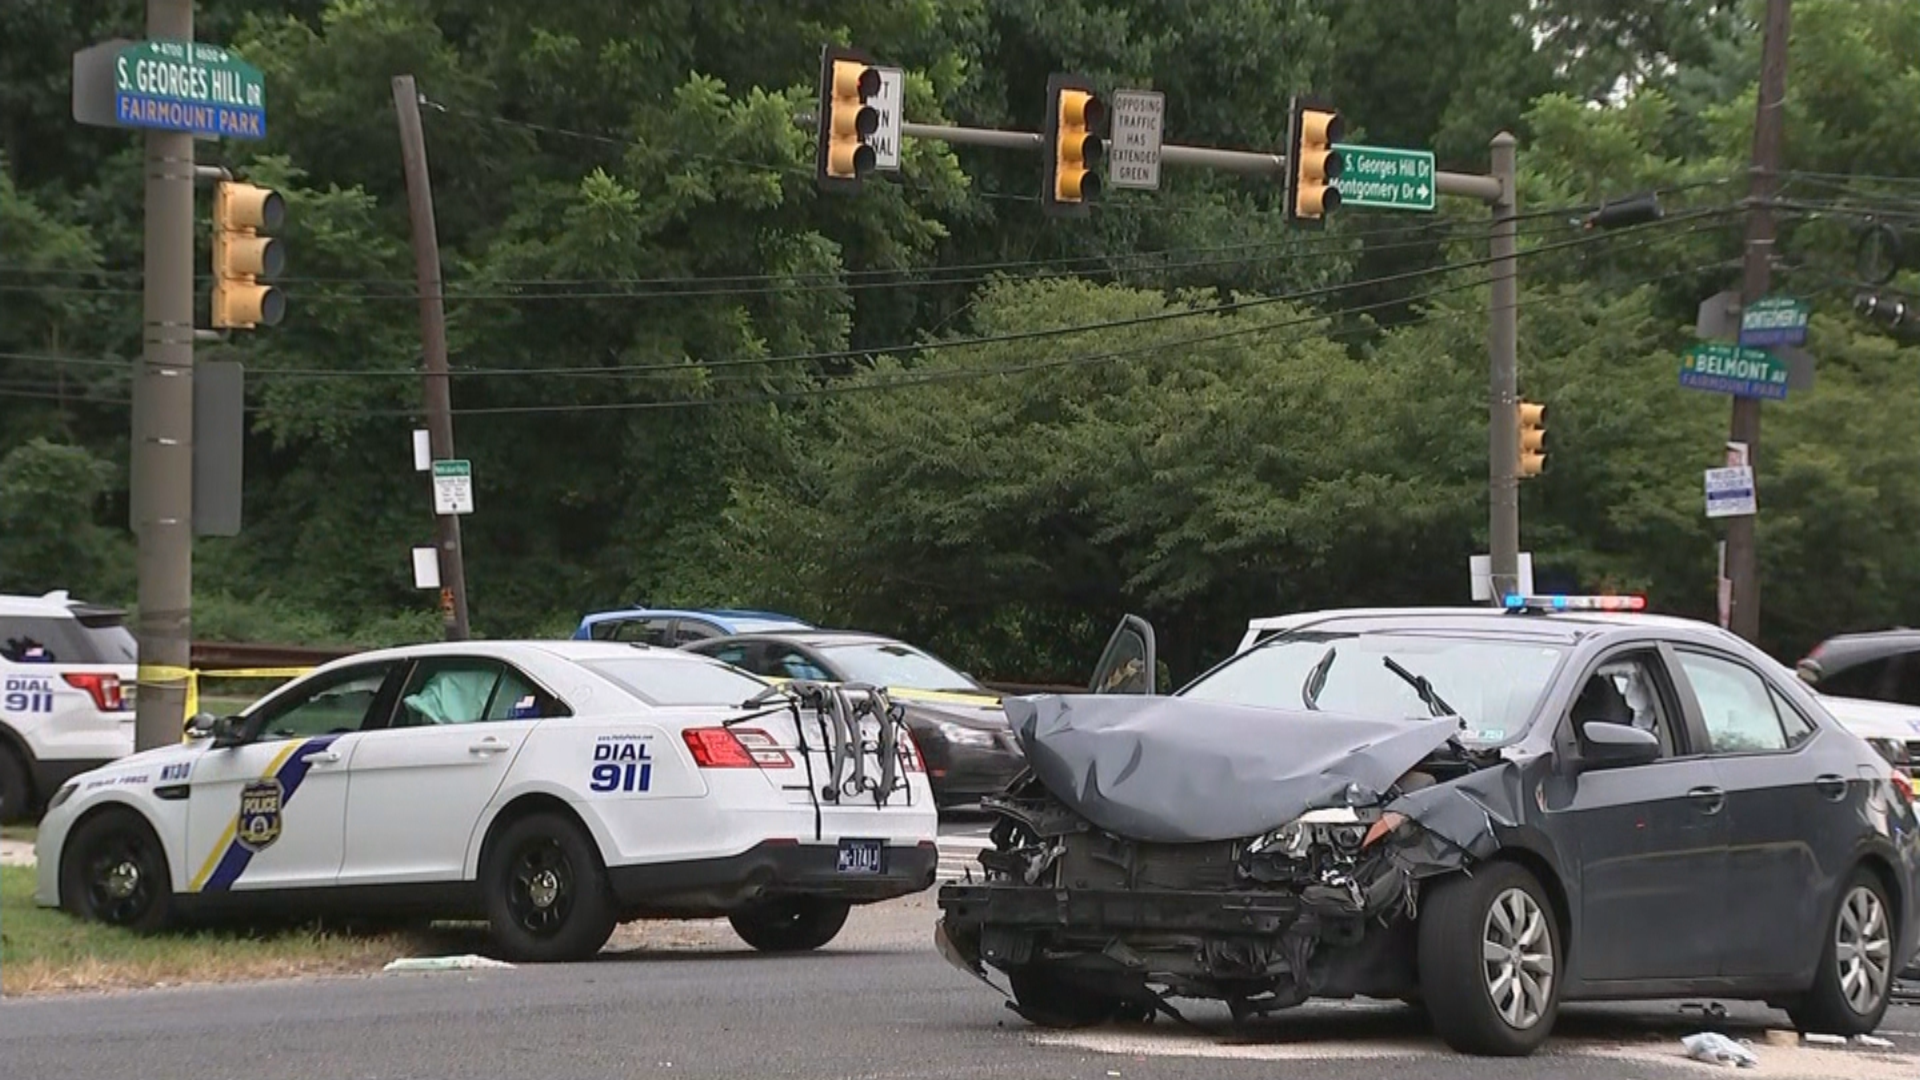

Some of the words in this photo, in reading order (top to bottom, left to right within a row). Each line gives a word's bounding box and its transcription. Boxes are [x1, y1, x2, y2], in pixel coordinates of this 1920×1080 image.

[118, 57, 132, 90] S.
[137, 59, 208, 101] GEORGES
[212, 70, 243, 104] HILL
[247, 83, 260, 106] DR
[1115, 97, 1160, 113] OPPOSING
[120, 97, 215, 129] FAIRMOUNT
[220, 109, 261, 136] PARK
[1120, 115, 1156, 130] TRAFFIC
[1127, 133, 1145, 147] HAS
[1113, 150, 1157, 164] EXTENDED
[1120, 167, 1149, 180] GREEN
[1357, 155, 1396, 179] Georges
[1399, 160, 1415, 176] Hill
[1418, 160, 1429, 178] Dr
[1402, 182, 1414, 199] Dr
[1742, 310, 1798, 329] MONTGOMERY
[1696, 354, 1770, 380] BELMONT
[1682, 373, 1749, 393] FAIRMOUNT
[1751, 383, 1783, 398] PARK
[6, 680, 53, 692] DIAL
[5, 693, 53, 713] 911
[594, 743, 651, 761] DIAL
[118, 776, 149, 785] FORCE
[590, 763, 651, 792] 911
[242, 799, 278, 816] POLICE
